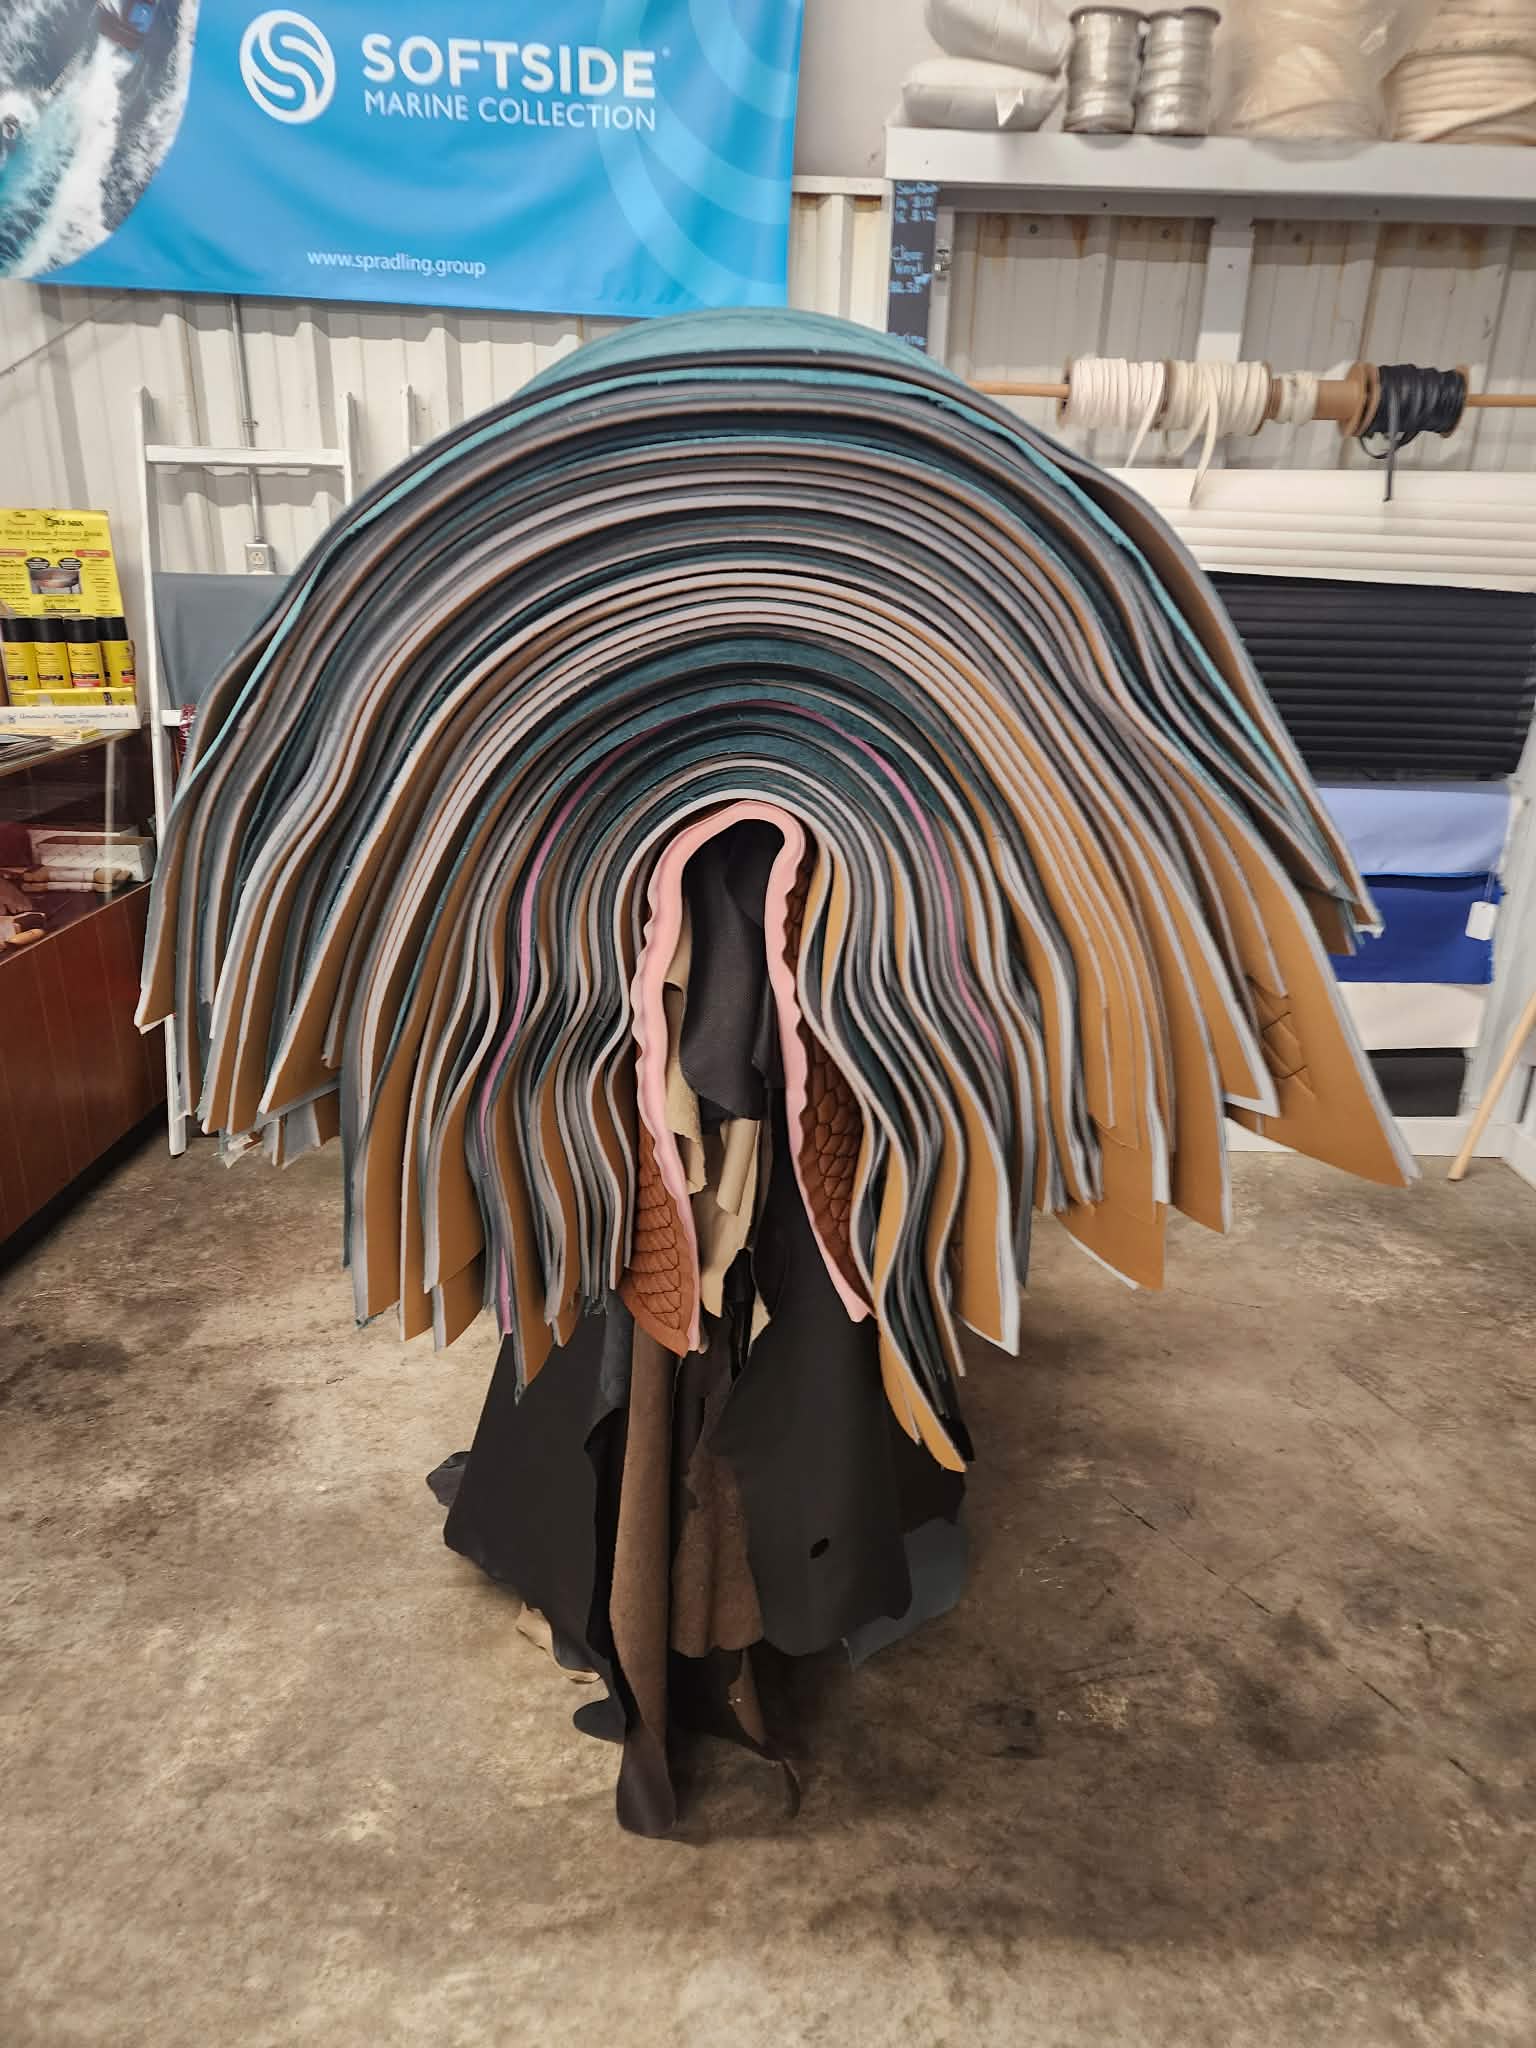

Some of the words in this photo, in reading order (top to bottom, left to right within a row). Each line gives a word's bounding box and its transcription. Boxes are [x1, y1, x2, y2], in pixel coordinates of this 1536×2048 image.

[361, 33, 657, 99] SOFTSIDE
[363, 90, 470, 121] MARINE
[478, 96, 657, 131] COLLECTION
[307, 251, 486, 278] www.spradling.group
